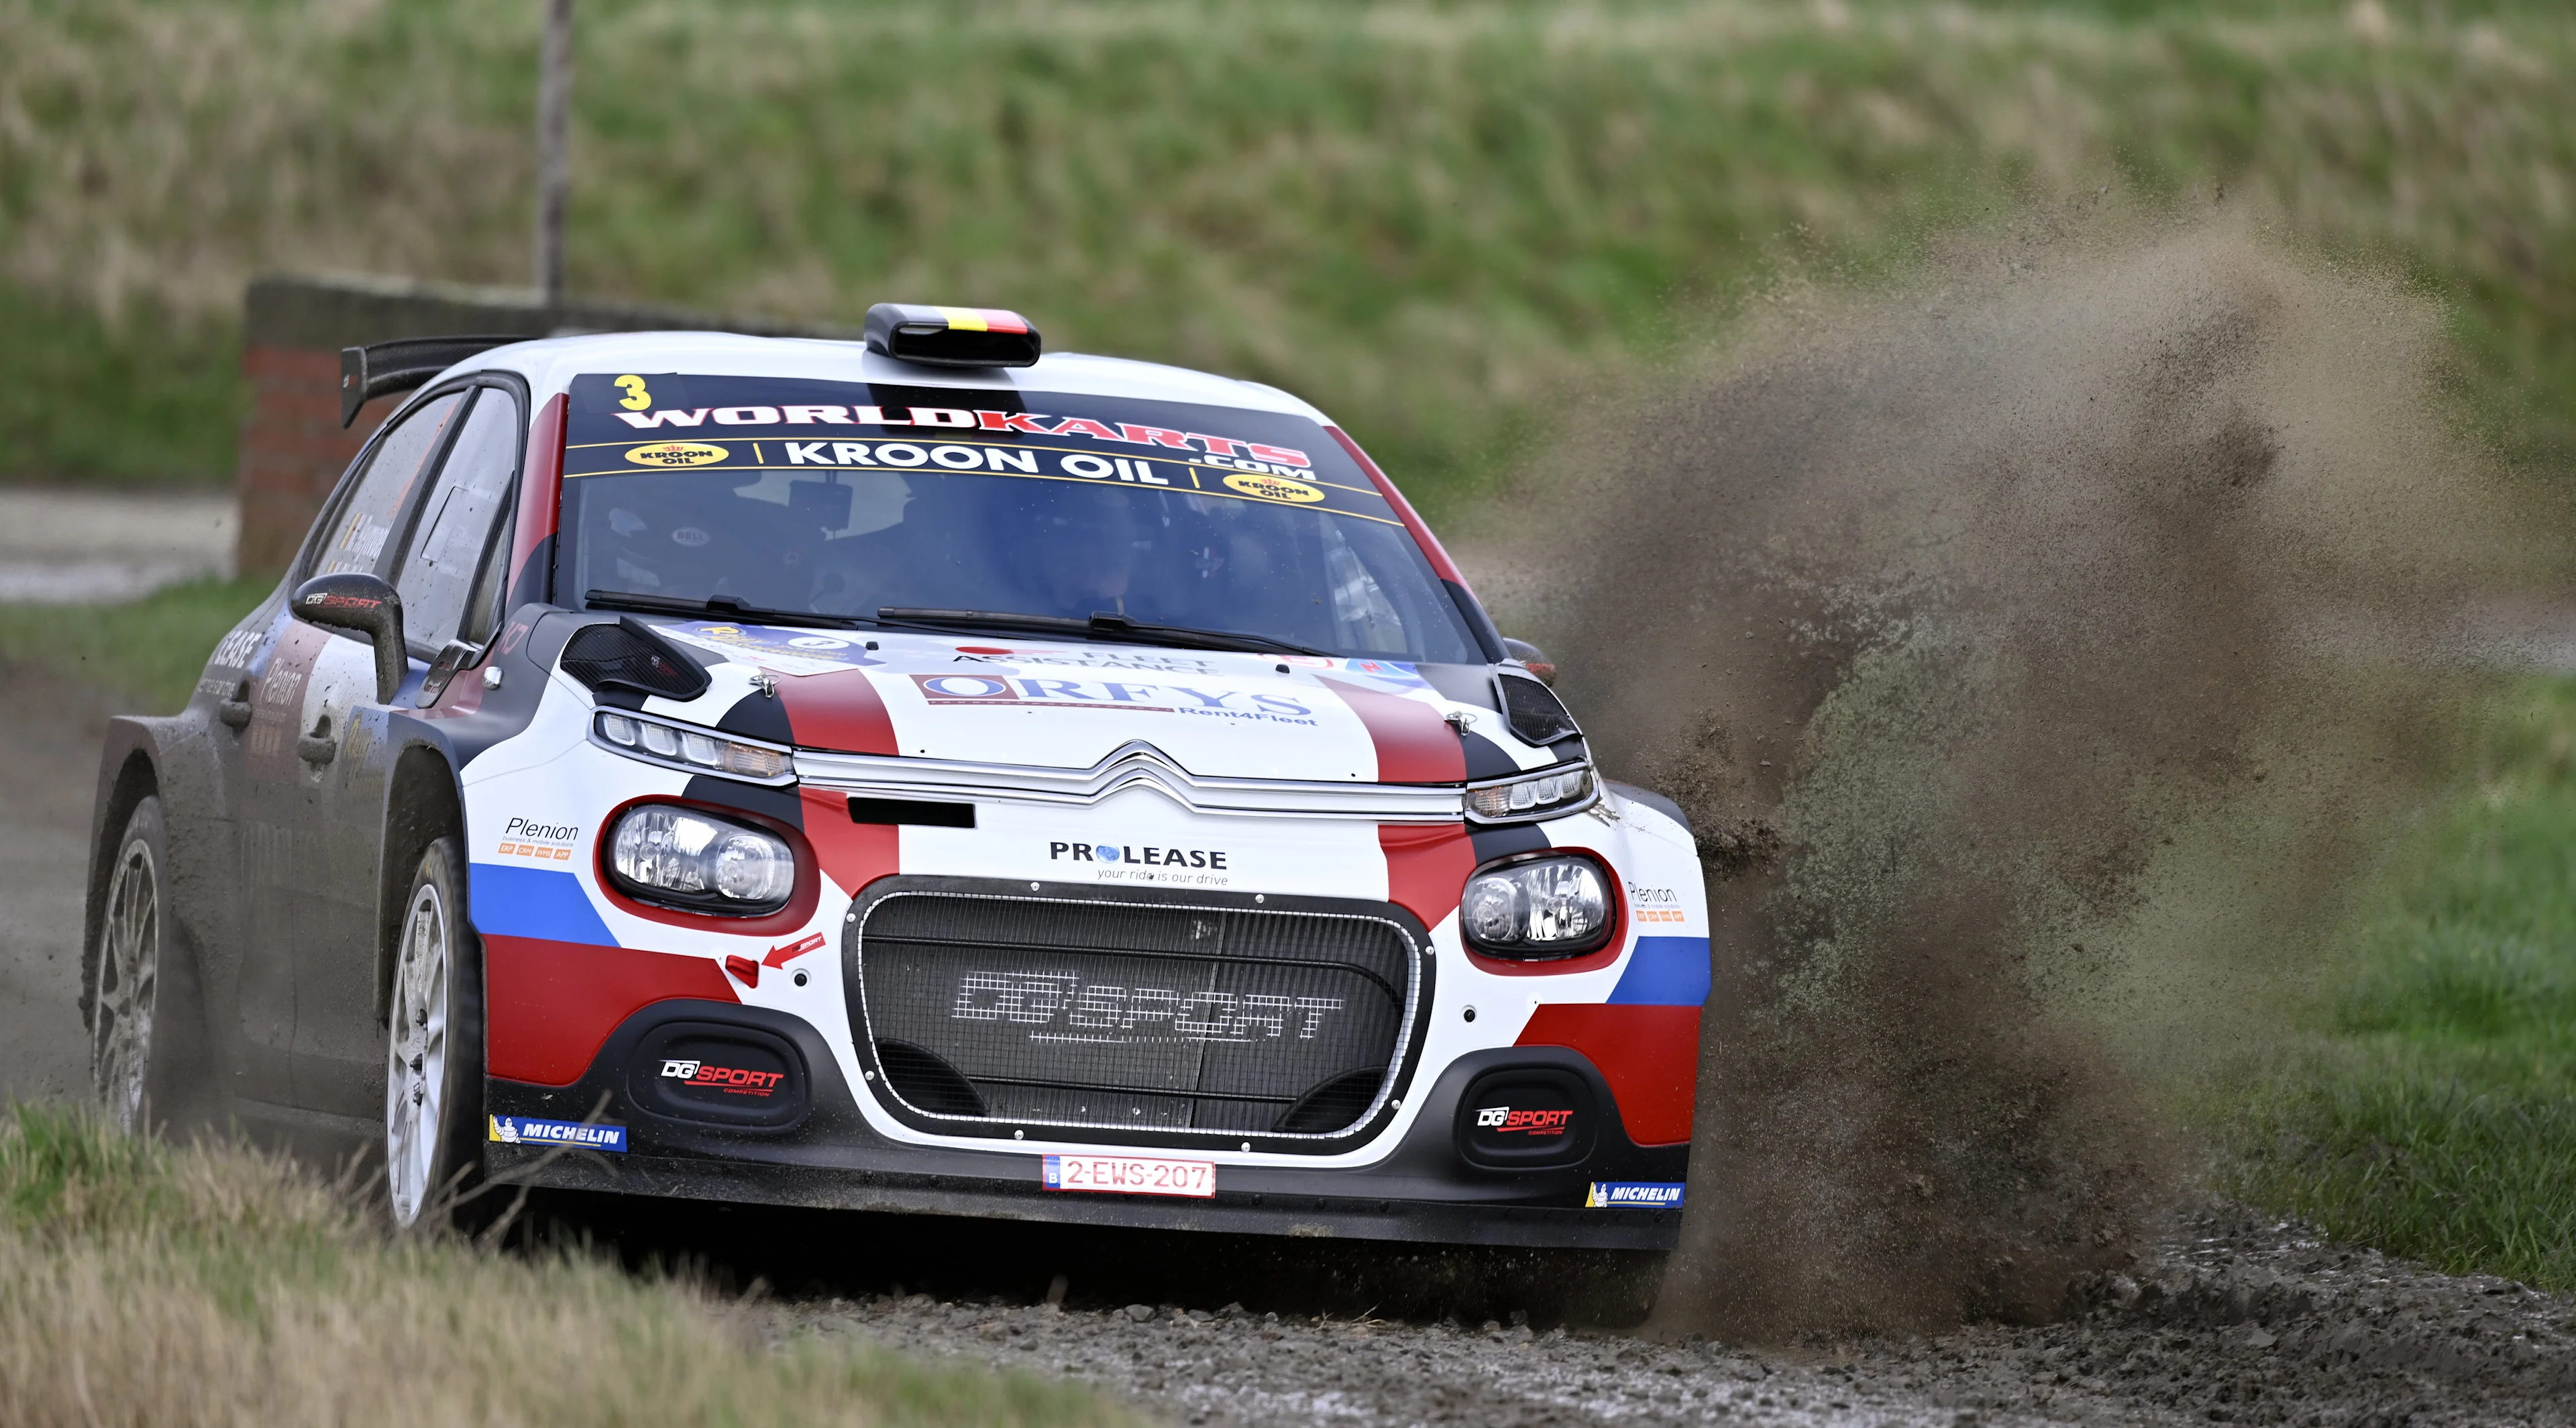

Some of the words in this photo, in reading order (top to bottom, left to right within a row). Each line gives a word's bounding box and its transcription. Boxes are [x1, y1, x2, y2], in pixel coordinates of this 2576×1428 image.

[614, 374, 651, 411] 3
[610, 405, 1311, 468] WORLDKARTS
[640, 450, 713, 459] KROON
[785, 442, 1038, 473] KROON
[1060, 454, 1169, 485] OIL
[1238, 480, 1309, 497] KROON
[1259, 490, 1291, 499] OIL
[953, 656, 1226, 676] ASSISTANCE
[1081, 652, 1216, 667] FLEET
[923, 676, 1313, 715] ORFYS
[1179, 707, 1319, 727] Rent4Fleet
[505, 817, 579, 840] Plenion
[1050, 842, 1228, 870] PROLEASE
[1097, 869, 1126, 880] your
[1158, 870, 1167, 881] is
[1172, 874, 1193, 884] our
[1197, 874, 1228, 886] drive
[1628, 881, 1677, 902] Plenion
[800, 936, 822, 949] SPORT
[1069, 985, 1346, 1040] SPORT
[696, 1065, 784, 1087] SPORT
[723, 1088, 770, 1097] COMPETITION
[1506, 1110, 1573, 1126] SPORT
[522, 1123, 620, 1144] MICHELIN
[1049, 1173, 1058, 1184] B
[1067, 1160, 1207, 1190] 2-EWS-207
[1611, 1187, 1680, 1201] MICHELIN
